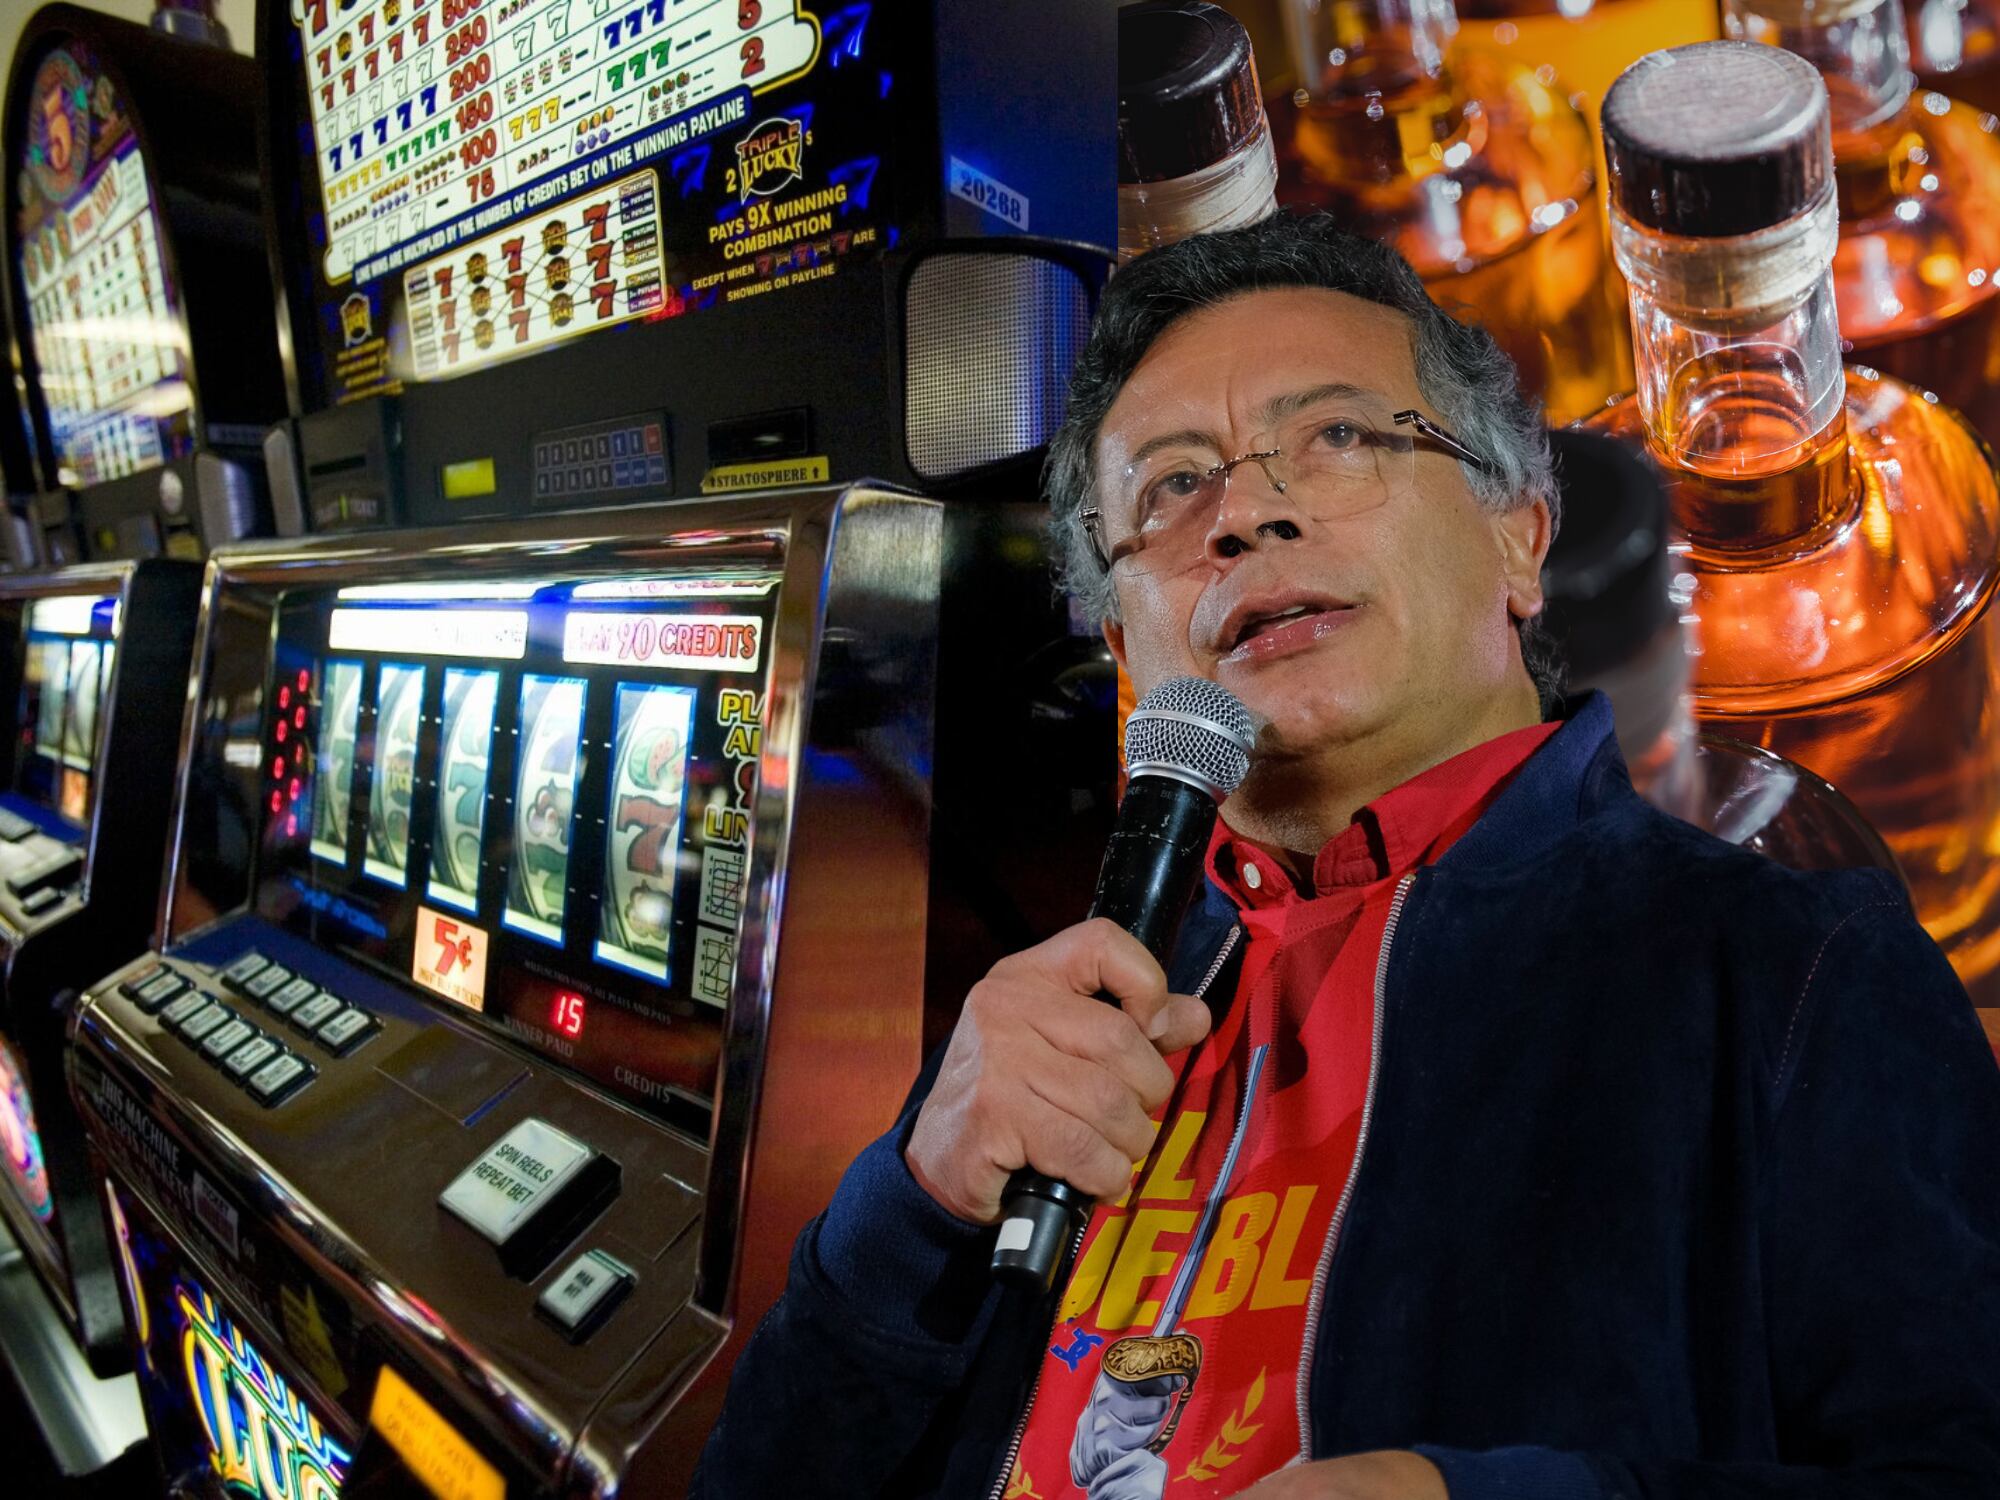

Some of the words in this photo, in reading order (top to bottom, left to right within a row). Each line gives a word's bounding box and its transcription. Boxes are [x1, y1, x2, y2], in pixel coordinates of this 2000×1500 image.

[446, 15, 487, 66] 250
[740, 37, 765, 79] 2
[449, 53, 491, 102] 200
[455, 91, 493, 134] 150
[459, 128, 497, 170] 100
[515, 191, 527, 214] OF
[527, 174, 568, 207] CREDITS
[569, 165, 590, 185] BET
[592, 158, 609, 180] ON
[611, 144, 633, 166] THE
[634, 122, 688, 160] WINNING
[690, 96, 745, 138] PAYLINE
[740, 124, 800, 158] TRIPLE
[466, 167, 495, 203] 75
[726, 168, 736, 193] 2
[742, 141, 799, 194] LUCKY
[709, 216, 745, 243] PAYS
[748, 201, 771, 230] 9X
[774, 184, 848, 222] WINNING
[960, 169, 1021, 222] 20288
[724, 212, 832, 260] COMBINATION
[693, 272, 724, 290] EXCEPT
[727, 263, 755, 281] WHEN
[853, 229, 876, 246] ARE
[727, 281, 772, 302] SHOWING
[774, 275, 789, 289] ON
[792, 263, 835, 286] PAYLINE
[716, 467, 808, 489] STRATOSPHERE
[618, 617, 657, 661] 90
[659, 623, 757, 660] CREDITS
[434, 917, 472, 976] 5¢
[503, 1014, 544, 1043] WINNER
[546, 1033, 574, 1058] PAID
[556, 995, 584, 1034] 15
[614, 1065, 671, 1104] CREDITS
[101, 1071, 124, 1113] THIS
[125, 1098, 179, 1172] MACHINE
[472, 1161, 515, 1191] REPEAT
[506, 1180, 534, 1204] BET
[495, 1143, 521, 1164] SPIN
[517, 1156, 554, 1183] REELS
[574, 1269, 596, 1288] MAX
